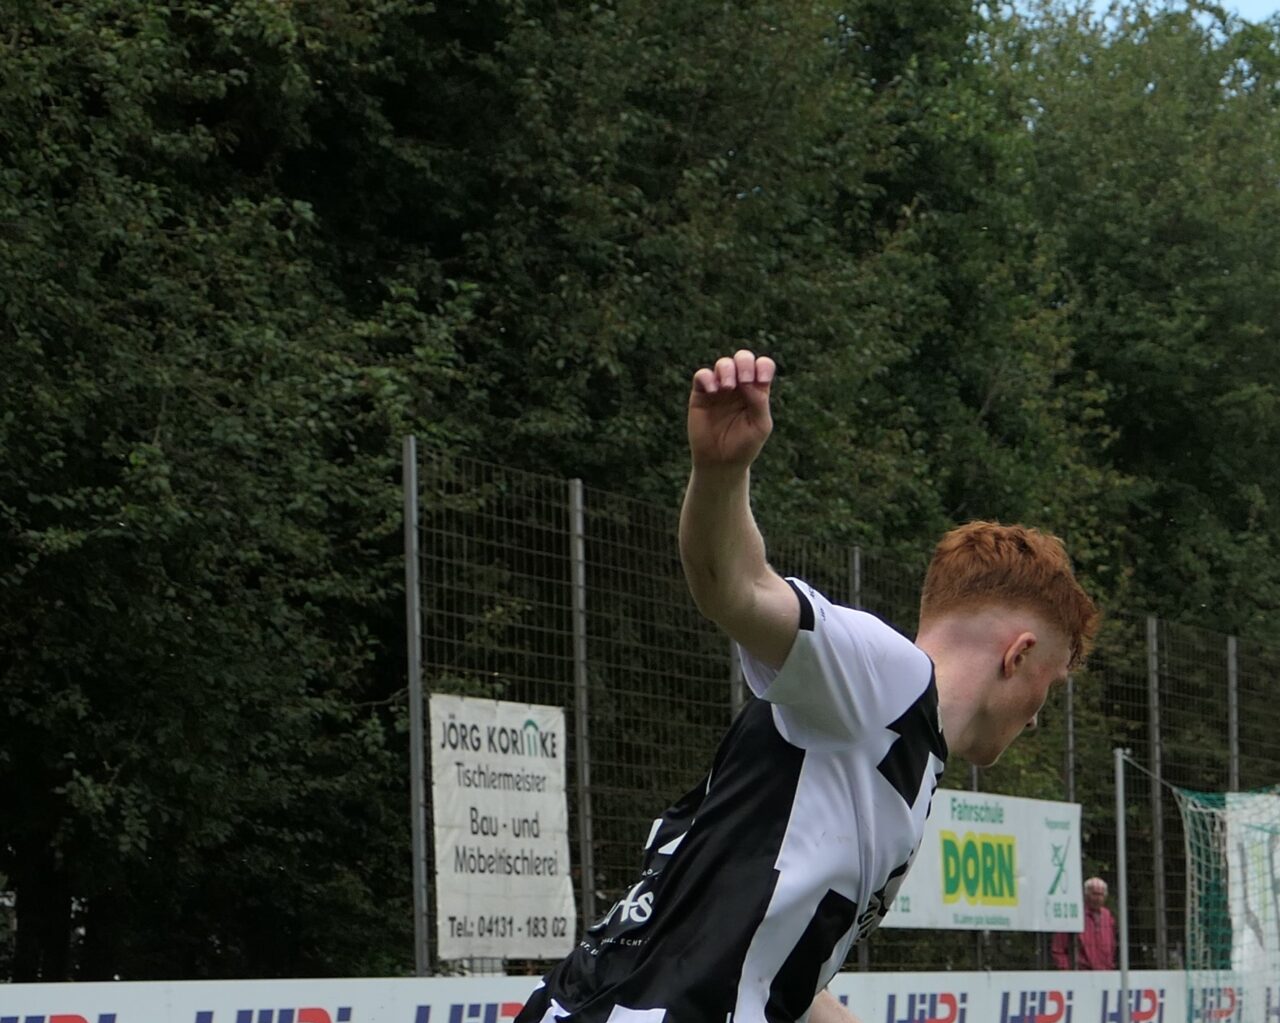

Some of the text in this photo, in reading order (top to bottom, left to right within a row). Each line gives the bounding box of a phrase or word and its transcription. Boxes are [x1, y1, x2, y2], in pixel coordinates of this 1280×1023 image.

[441, 713, 482, 752] JÖRG
[455, 761, 547, 793] Tischlermeister
[470, 806, 498, 837] Bau
[512, 810, 540, 838] und
[454, 845, 558, 876] Möbeltischlerei
[943, 838, 1015, 898] DORN
[448, 915, 474, 937] Tel.:
[478, 915, 514, 938] 04131
[527, 915, 547, 938] 183
[552, 915, 567, 938] 02
